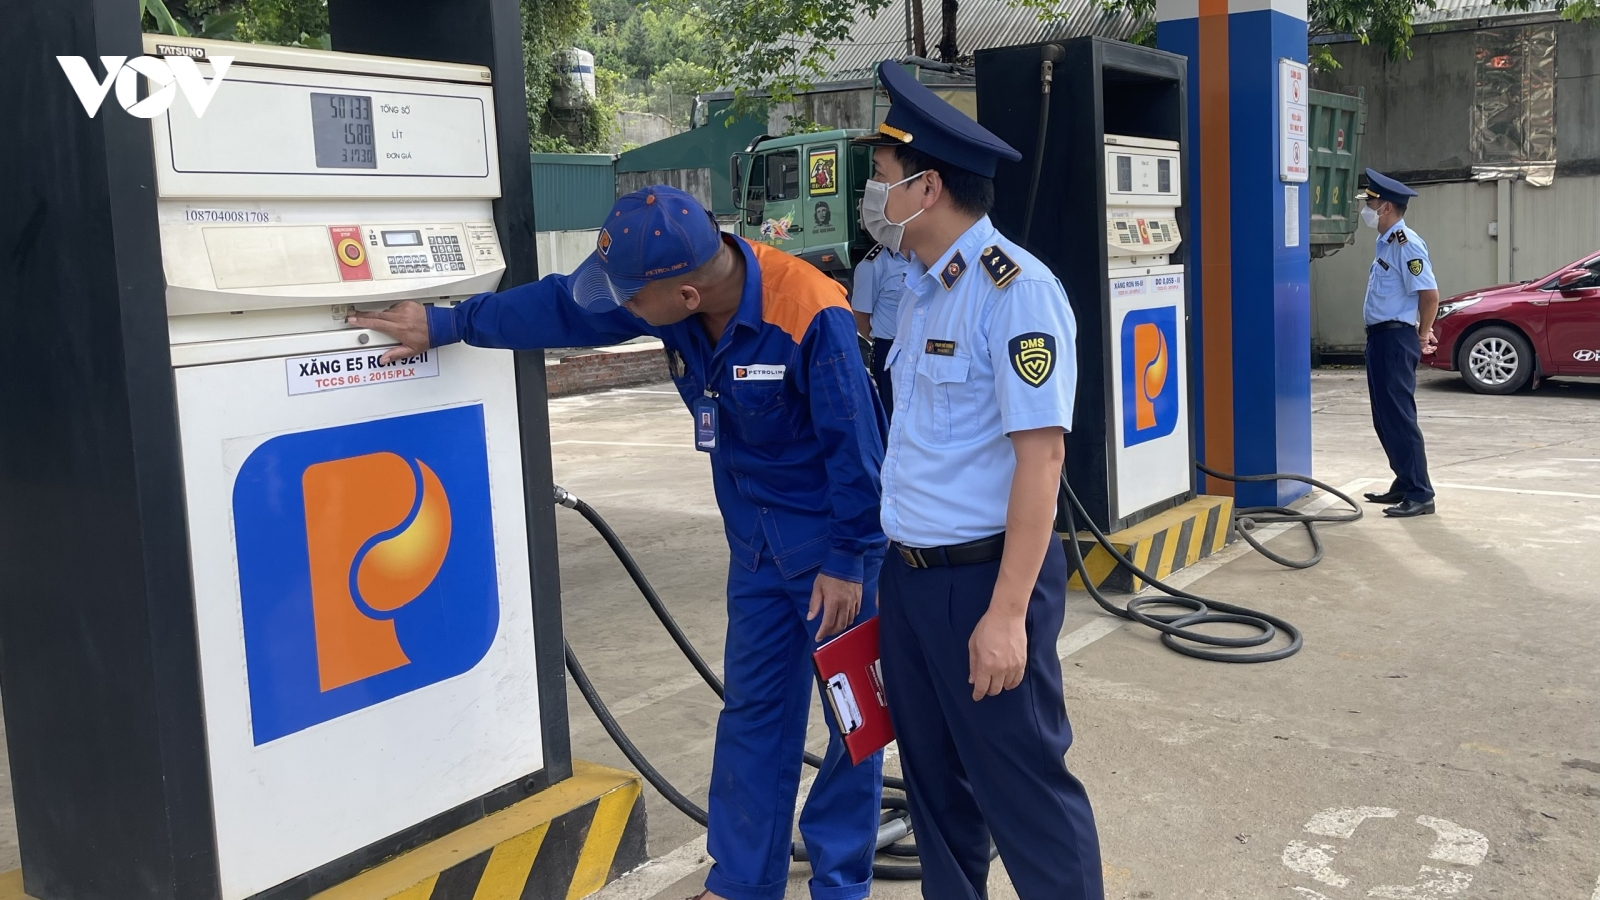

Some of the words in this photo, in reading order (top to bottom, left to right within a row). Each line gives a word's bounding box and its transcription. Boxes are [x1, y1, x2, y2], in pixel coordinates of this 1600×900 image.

[158, 45, 204, 58] TATSUNO
[330, 96, 370, 120] 50133
[380, 104, 399, 114] TỔNG
[401, 106, 410, 114] SỐ
[392, 129, 403, 139] LÍT
[342, 149, 372, 162] 31730
[185, 210, 269, 222] 1087040081708
[645, 262, 688, 276] PETROLIMEX
[1020, 338, 1045, 350] DMS
[299, 358, 341, 376] XĂNG
[347, 357, 363, 372] E5
[315, 377, 345, 388] TCCS
[348, 375, 360, 384] 06
[370, 368, 415, 381] 2015/PLX
